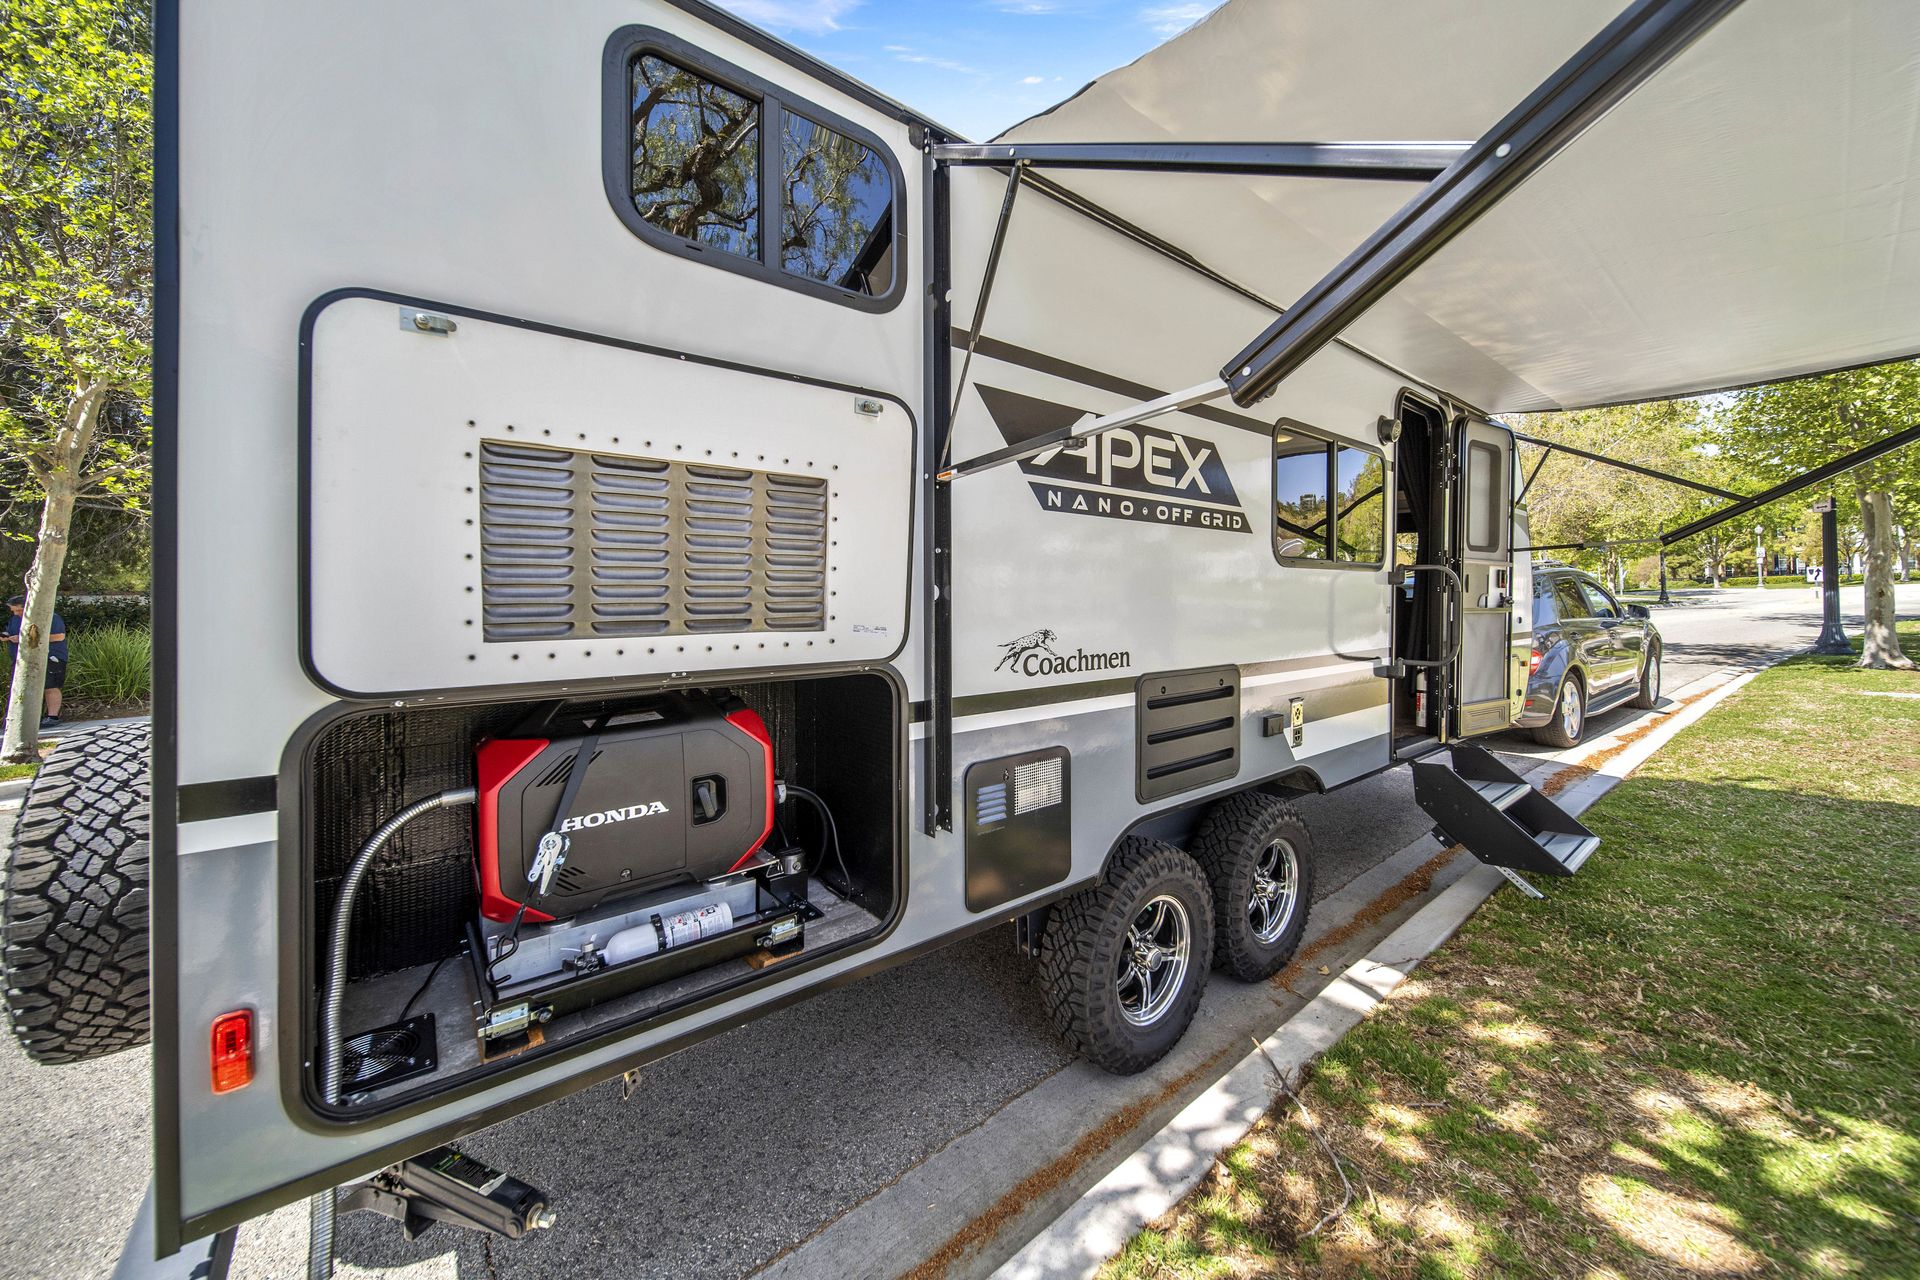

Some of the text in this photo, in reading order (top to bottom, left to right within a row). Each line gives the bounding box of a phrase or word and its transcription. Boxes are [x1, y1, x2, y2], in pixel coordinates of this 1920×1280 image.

[1031, 413, 1211, 494] APEX
[1048, 491, 1242, 529] NANO OFF GRID
[1022, 648, 1131, 677] Coachmen
[559, 800, 669, 833] HONDA
